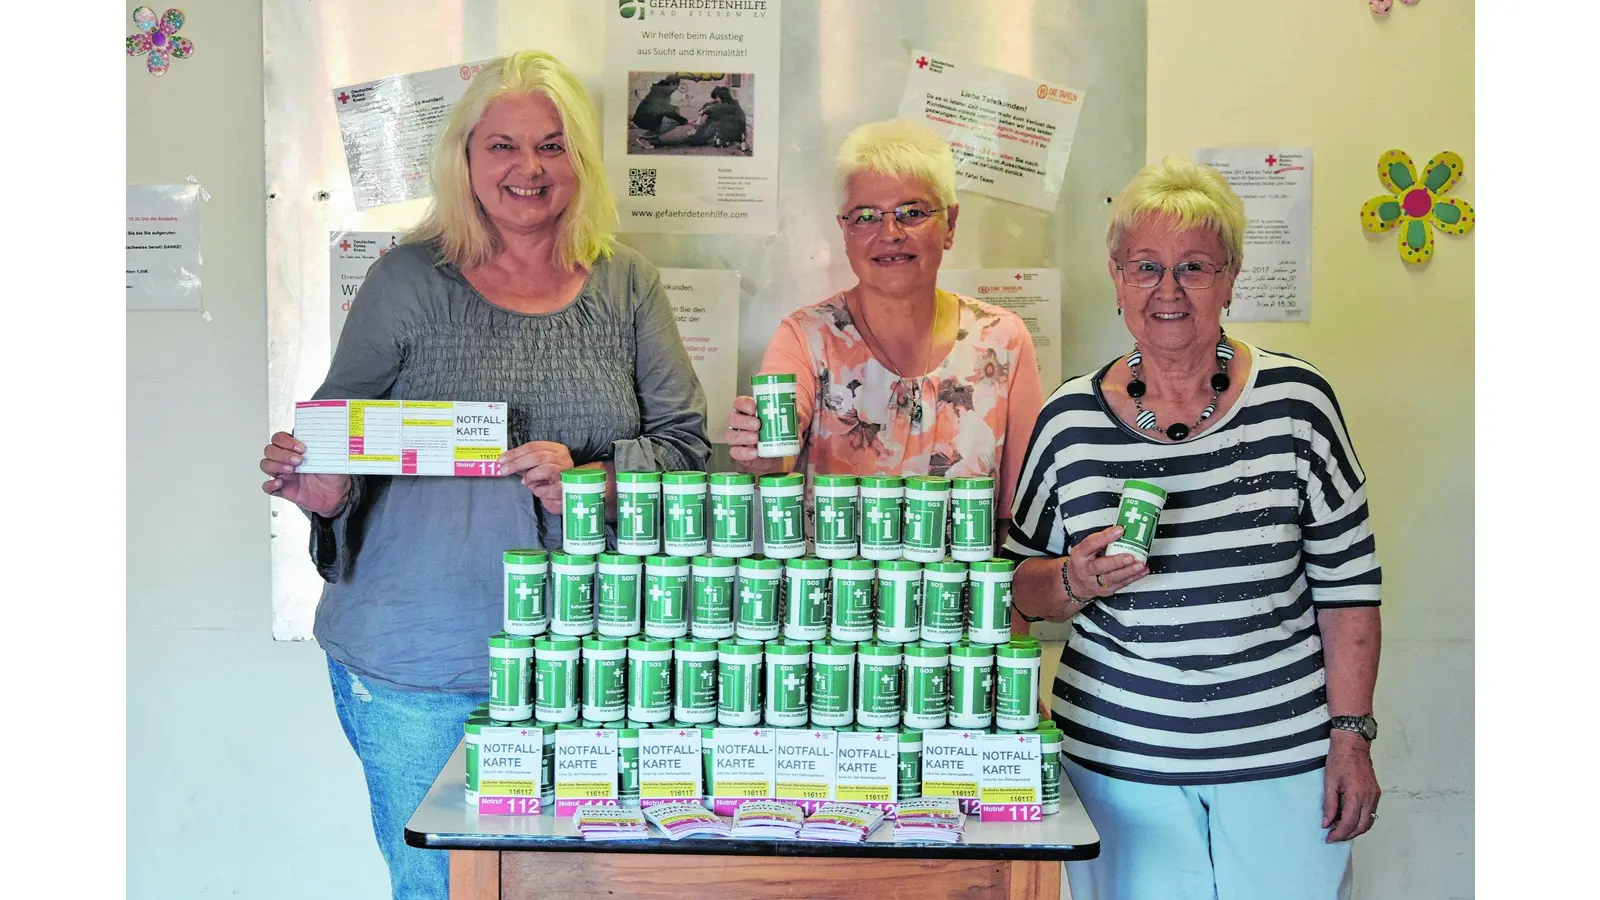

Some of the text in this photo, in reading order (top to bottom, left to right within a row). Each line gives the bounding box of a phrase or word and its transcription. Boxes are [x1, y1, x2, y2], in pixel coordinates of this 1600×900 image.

[641, 31, 744, 42] Wir helfen beim Ausstieg
[653, 48, 676, 56] Sucht
[678, 48, 694, 56] und
[696, 48, 747, 57] Kriminalität!
[1048, 87, 1078, 102] DIE TAFELN
[961, 90, 1028, 112] Liebe Tafelkunden!
[979, 175, 994, 184] Team
[631, 209, 748, 223] www.gefaehrdetenhilfe.com
[456, 416, 505, 424] NOTFALL-
[484, 744, 540, 753] NOTFALL-
[559, 746, 615, 755] NOTFALL-
[643, 745, 699, 754] NOTFALL-
[717, 745, 773, 754] NOTFALL-
[778, 746, 834, 756] NOTFALL-
[839, 749, 895, 758] NOTFALL-
[982, 751, 1038, 760] NOTFALL-
[483, 758, 521, 767] KARTE
[559, 759, 597, 769] KARTE
[643, 759, 681, 768] KARTE
[717, 759, 755, 768] KARTE
[777, 760, 815, 770] KARTE
[926, 760, 964, 769] KARTE
[838, 763, 877, 772] KARTE
[983, 765, 1021, 774] KARTE
[507, 799, 539, 813] 112
[1009, 806, 1041, 821] 112
